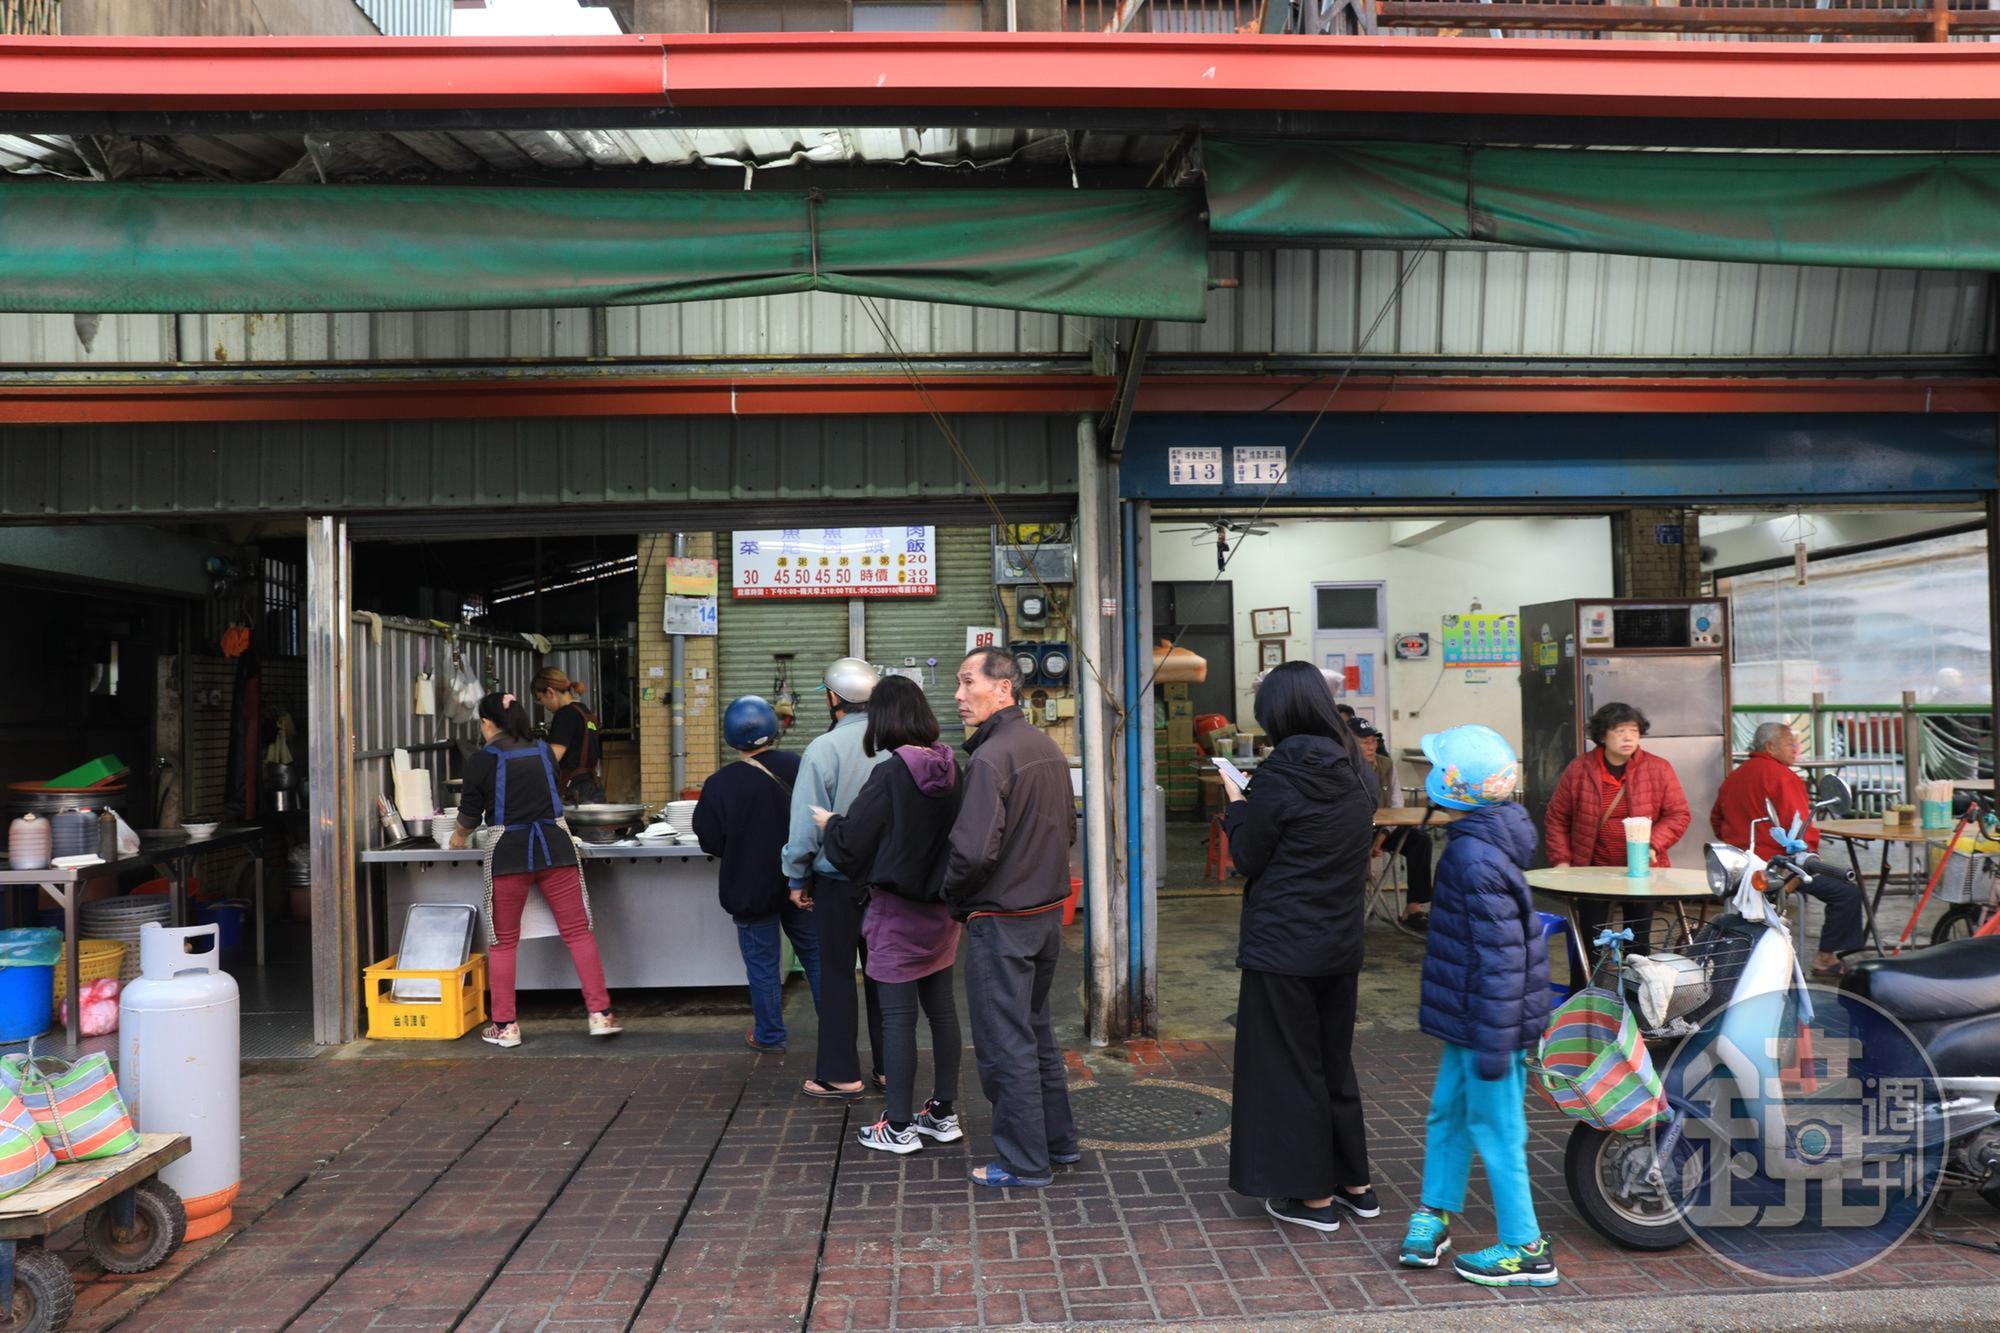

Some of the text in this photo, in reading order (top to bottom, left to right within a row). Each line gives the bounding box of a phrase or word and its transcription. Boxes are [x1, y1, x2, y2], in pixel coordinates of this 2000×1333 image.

[1188, 464, 1216, 480] 13
[1253, 463, 1280, 479] 15
[907, 554, 927, 564] 20
[743, 569, 759, 584] 30
[774, 569, 790, 584] 45
[795, 569, 811, 584] 50
[815, 568, 831, 584] 45
[836, 568, 852, 584] 50
[860, 568, 889, 582] 時價
[907, 568, 928, 577] 30
[907, 576, 928, 584] 40
[699, 606, 717, 622] 14
